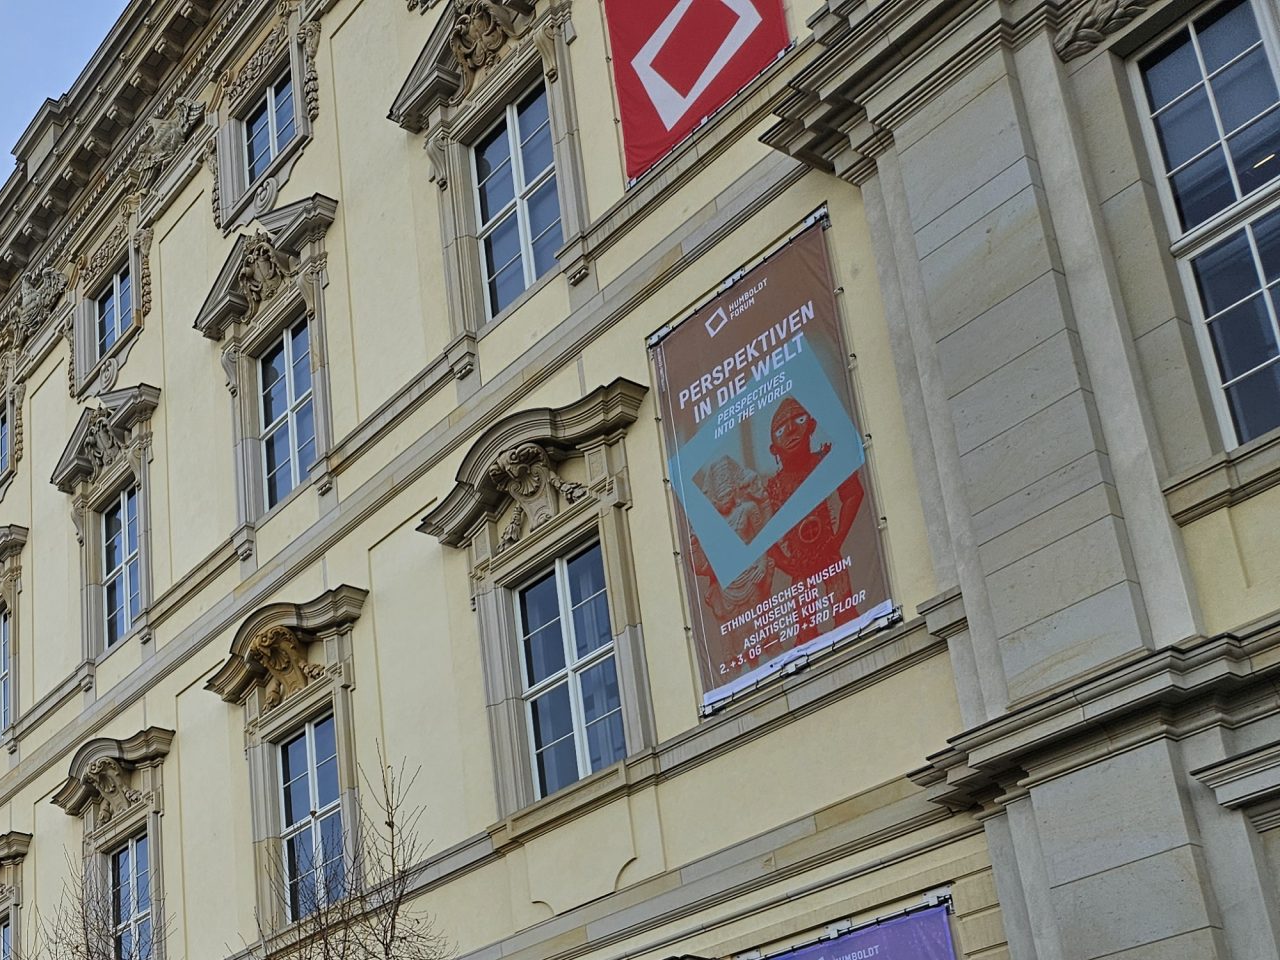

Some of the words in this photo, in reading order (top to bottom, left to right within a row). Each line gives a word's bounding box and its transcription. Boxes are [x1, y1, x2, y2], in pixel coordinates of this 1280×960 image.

[728, 277, 768, 312] HUMBOLDT
[730, 298, 755, 320] FORUM
[679, 300, 815, 409] PERSPEKTIVEN
[693, 397, 712, 424] IN
[716, 373, 747, 408] DIE
[750, 332, 805, 382] WELT
[714, 420, 735, 440] INTO
[737, 407, 755, 427] THE
[757, 379, 793, 411] WORLD
[717, 371, 785, 424] PERSPECTIVES
[720, 582, 805, 635] ETHNOLOGISCHES
[806, 555, 852, 589] MUSEUM
[743, 613, 799, 649] ASIATISCHE
[801, 592, 835, 617] KUNST
[753, 600, 796, 630] MUSEUM
[798, 586, 819, 607] FÜR
[719, 662, 730, 675] 2.
[737, 652, 747, 666] 3.
[749, 644, 762, 660] OG
[779, 624, 800, 642] 2ND
[801, 622, 808, 631] +
[809, 610, 829, 627] 3RD
[832, 589, 866, 616] FLOOR
